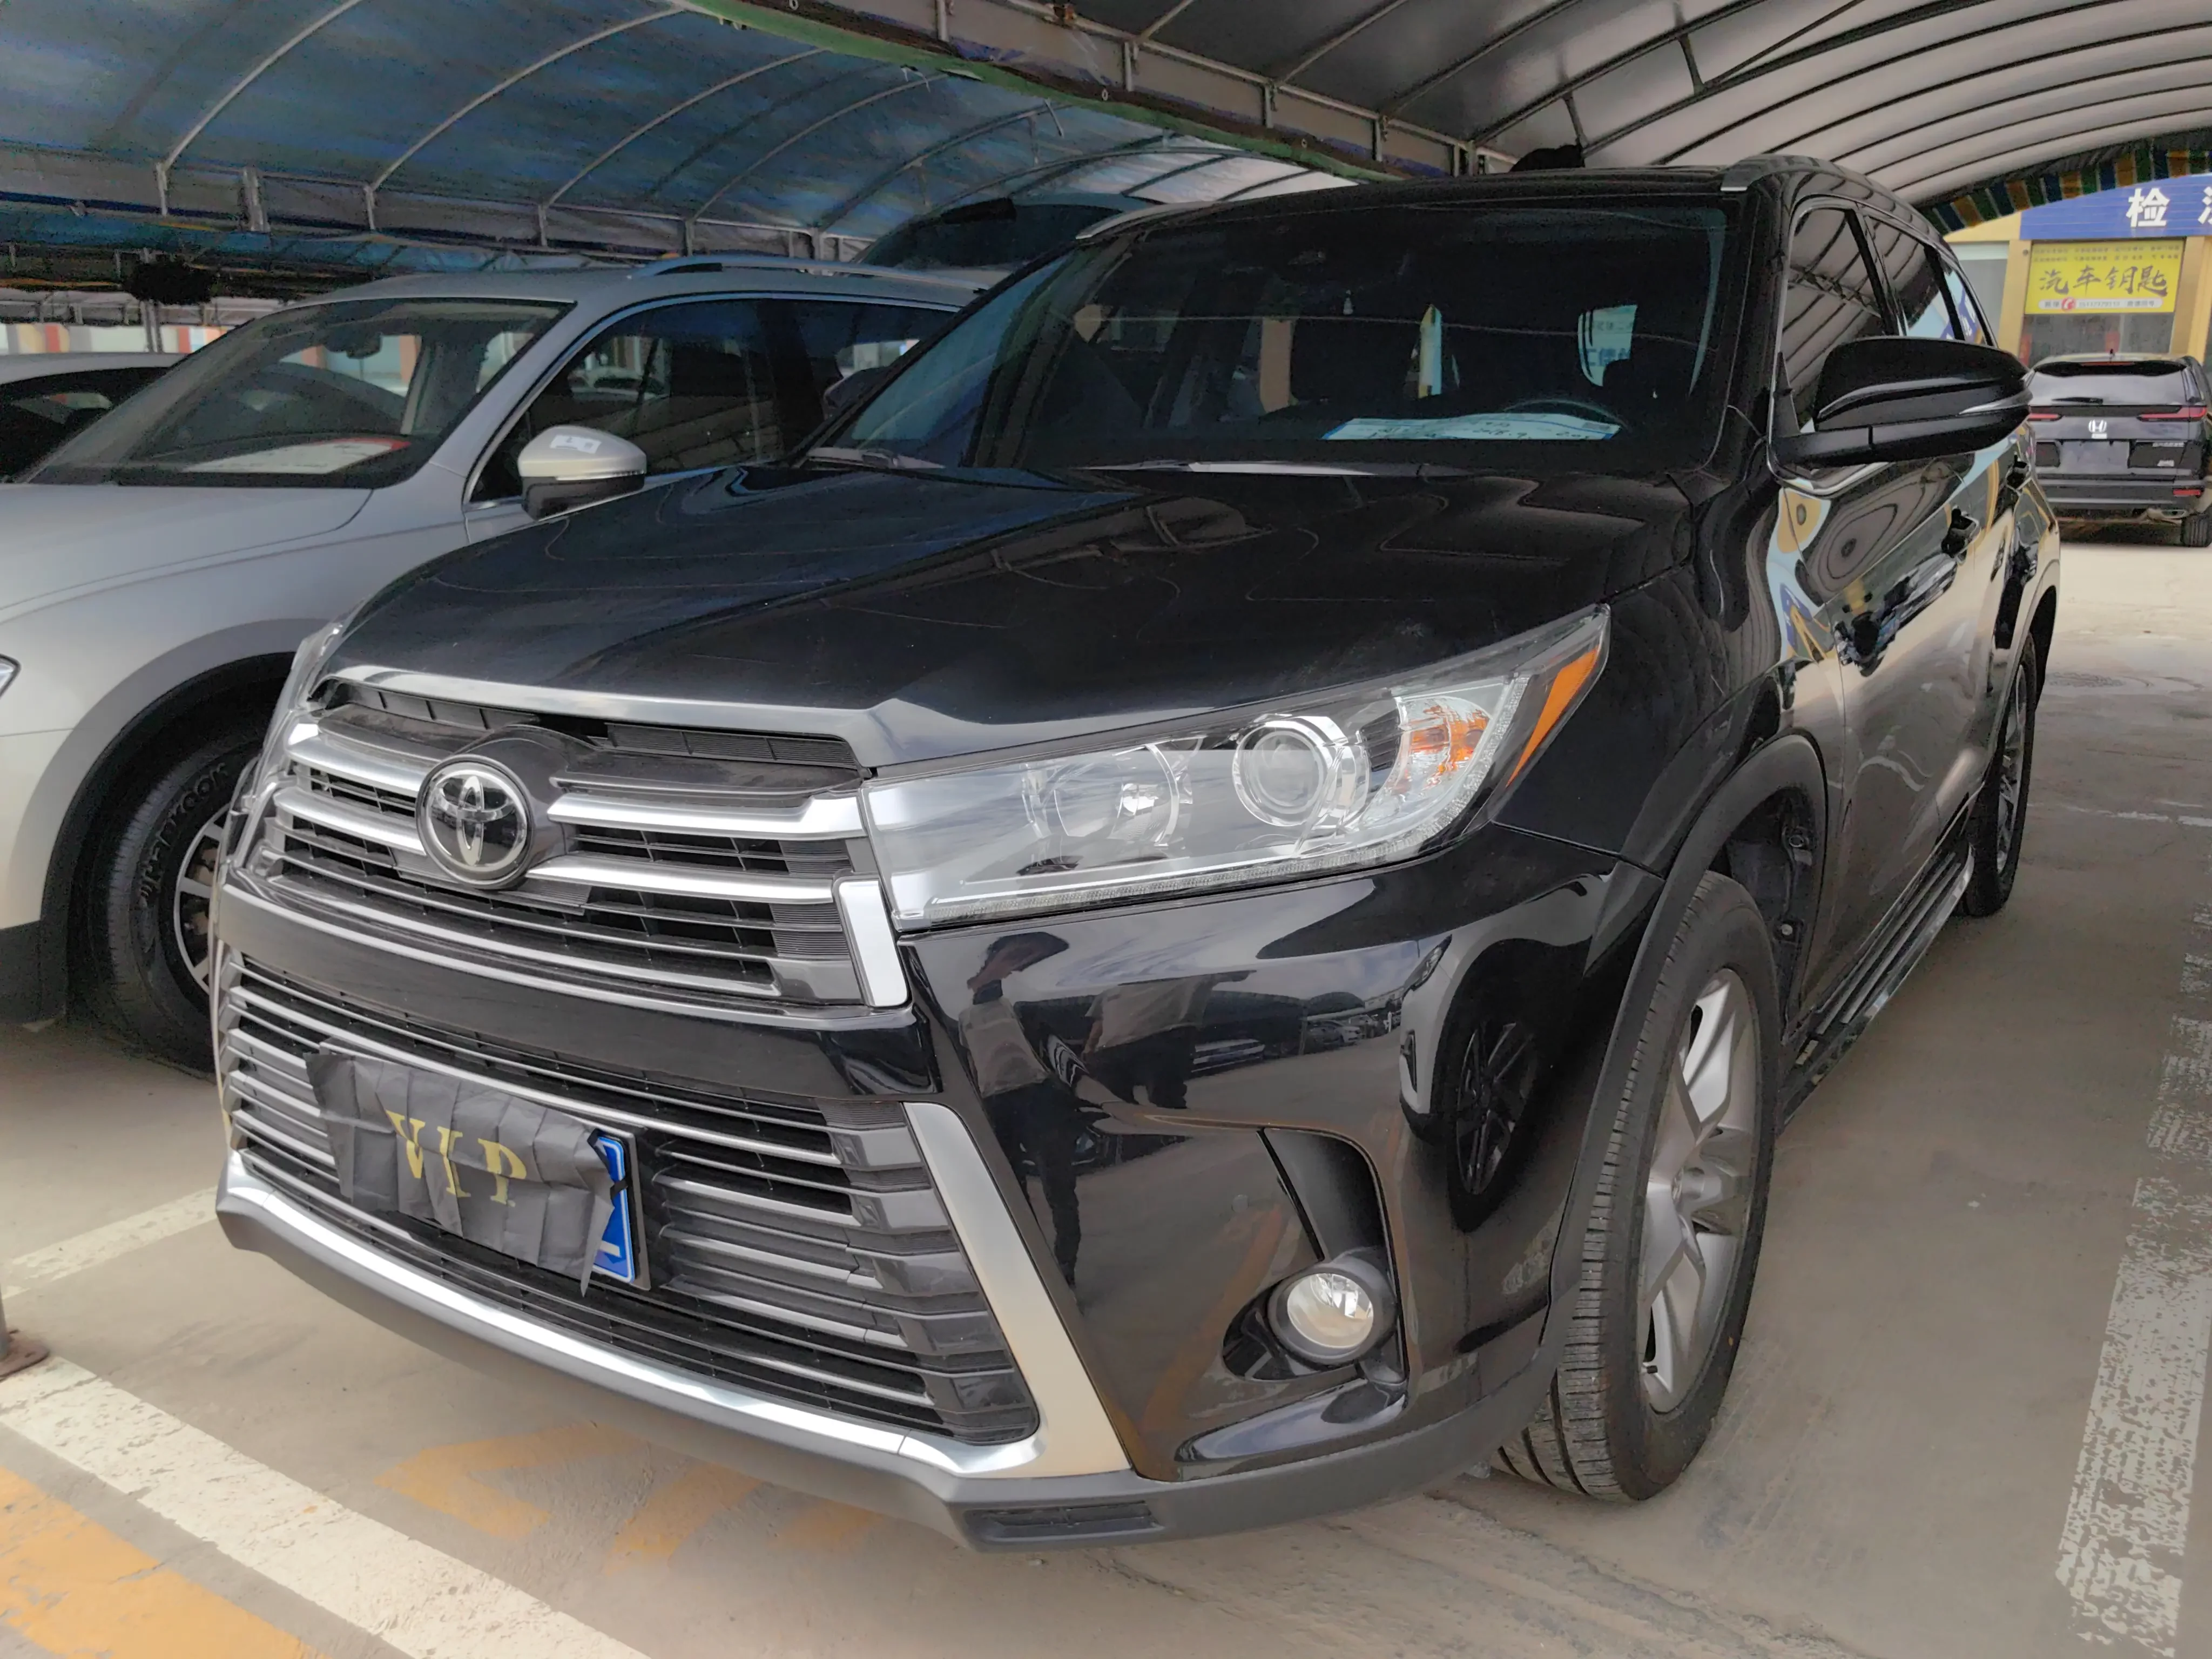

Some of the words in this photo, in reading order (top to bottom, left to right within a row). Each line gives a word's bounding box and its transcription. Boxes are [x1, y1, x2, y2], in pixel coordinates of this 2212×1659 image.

[2039, 264, 2168, 296] 汽车钥匙
[386, 1109, 527, 1207] VIP
